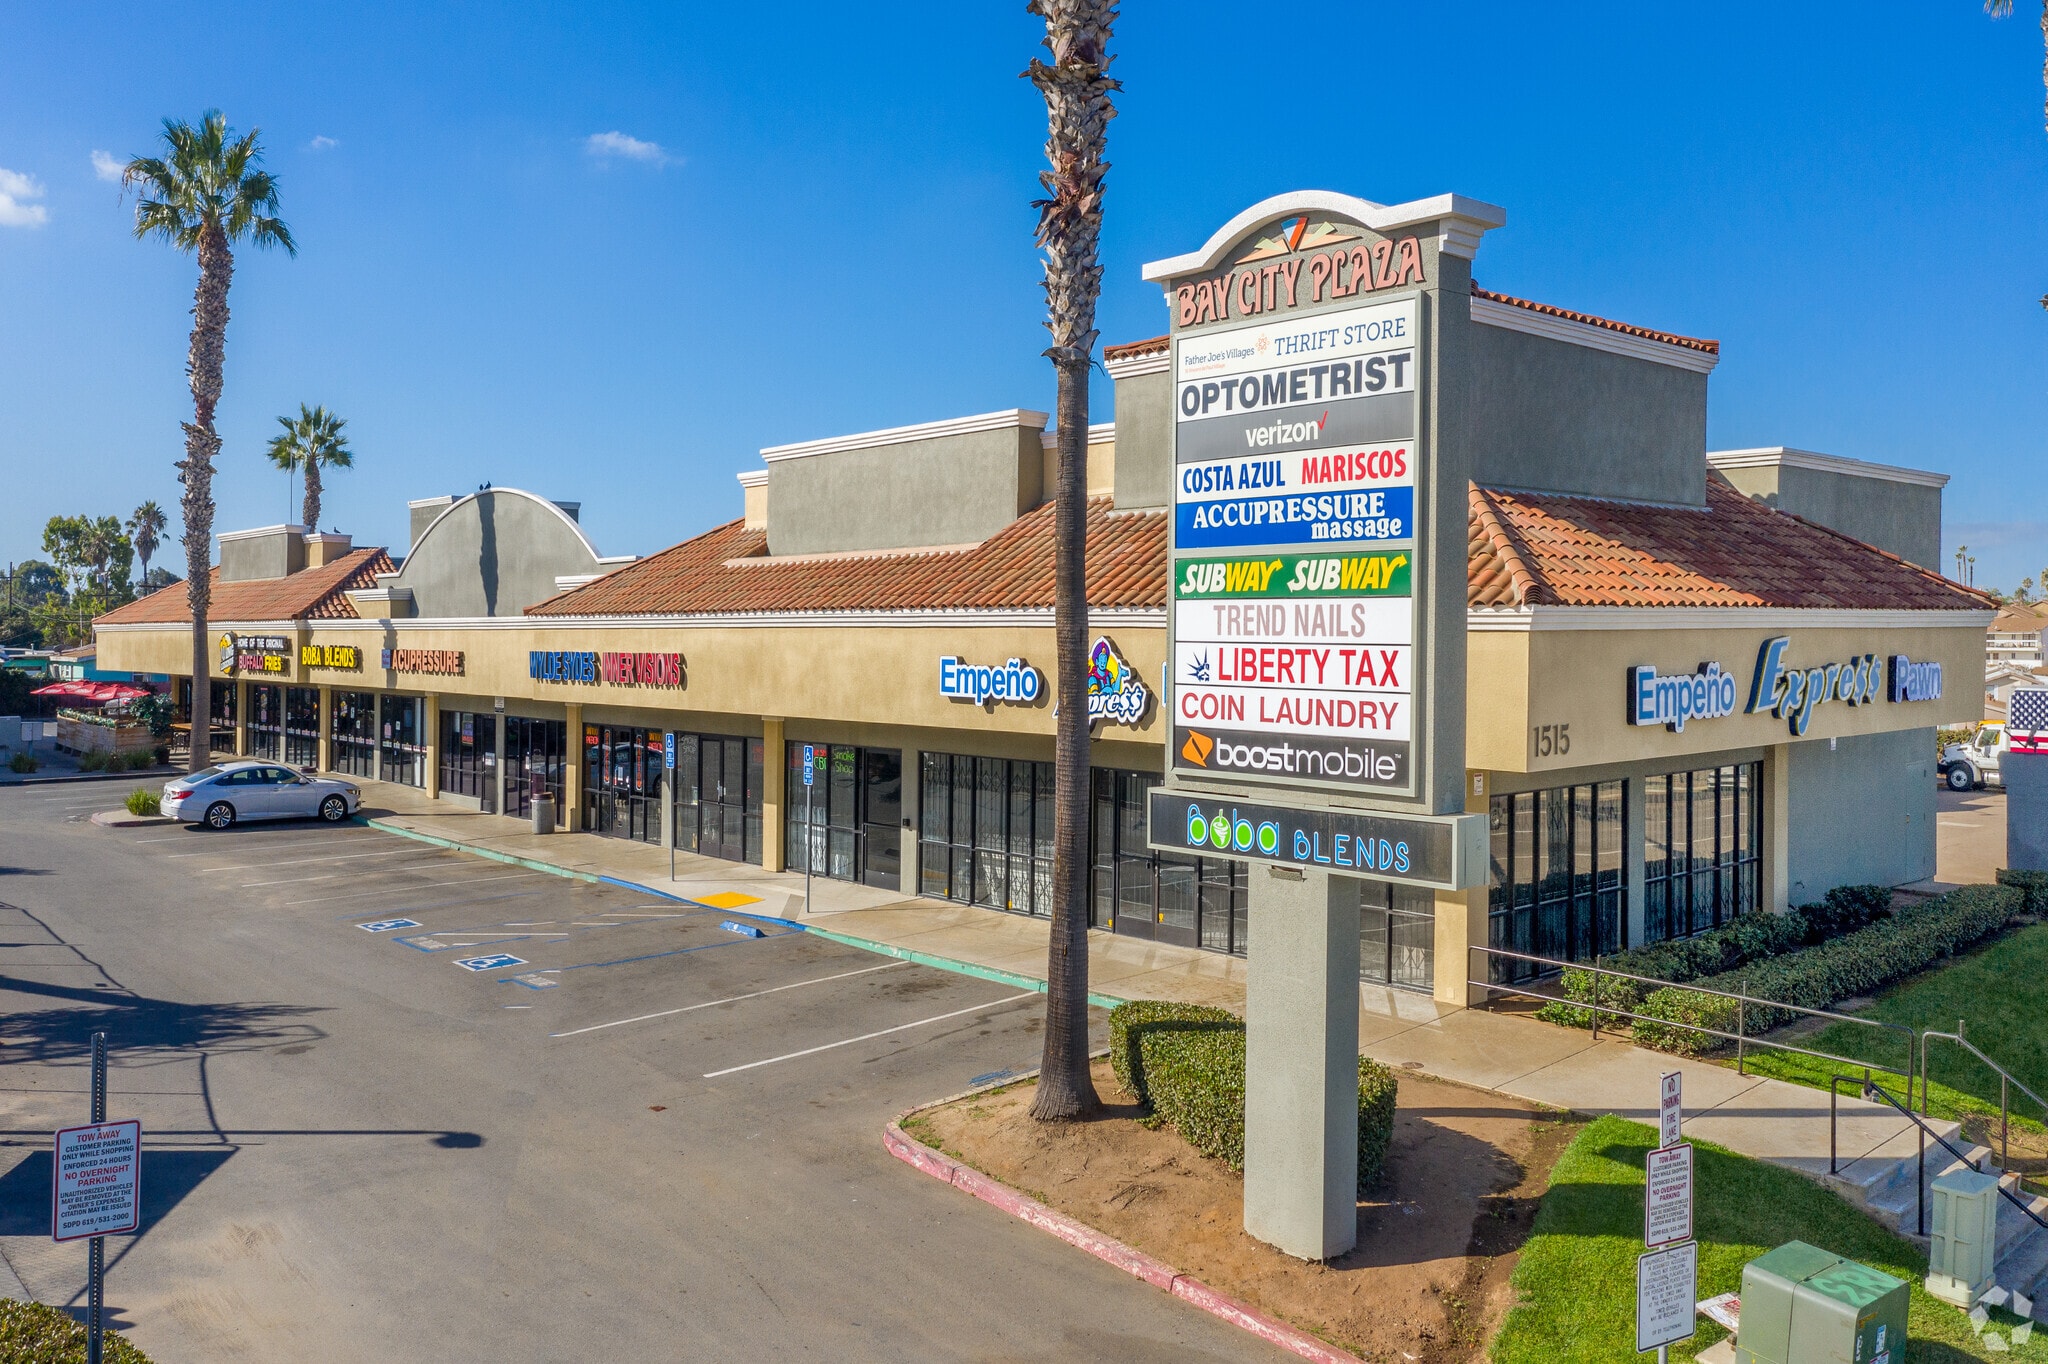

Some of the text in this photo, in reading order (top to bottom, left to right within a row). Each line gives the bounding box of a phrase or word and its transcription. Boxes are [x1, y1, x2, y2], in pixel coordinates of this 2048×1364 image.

[1177, 235, 1425, 327] BAY CITY PLAZA
[1275, 317, 1406, 356] THRIFT STORE
[1185, 347, 1254, 366] Father Joe's Villages
[1181, 353, 1410, 416] OPTOMETRIST
[1246, 419, 1319, 447] verizon
[1183, 449, 1406, 494] COSTA AZUL MARISCOS
[1193, 492, 1386, 528] ACCUPRESSURE
[1312, 518, 1402, 539] massage
[1179, 553, 1407, 595] SUBWAY SUBWAY
[1214, 603, 1366, 638] TREND NAILS
[238, 638, 284, 648] HOME OF THE ORIGINAL
[238, 655, 263, 670] BUFFALO
[264, 655, 282, 671] FRIES
[302, 646, 354, 668] BOBA BLENDS
[392, 649, 460, 672] ACUPRESSURE
[529, 651, 680, 686] WYLDE SYDES INNER VISIONS
[1218, 648, 1399, 687] LIBERTY TAX
[940, 657, 1038, 704] Empeño
[1638, 665, 1735, 729] Empeño
[1896, 656, 1941, 702] Pawn
[1182, 692, 1398, 730] COIN LAUNDRY
[1533, 723, 1570, 758] 1515
[833, 748, 855, 762] Smoke
[834, 761, 854, 776] Shop
[1294, 830, 1410, 872] BLENDS
[1668, 1080, 1675, 1094] NO
[1667, 1112, 1676, 1124] FIRE
[77, 1130, 120, 1143] TOW AWAY
[1666, 1125, 1676, 1139] LANE
[66, 1138, 131, 1152] CUSTOMER PARKING
[80, 1150, 100, 1158] WHILE
[101, 1145, 134, 1155] SHOPPING
[64, 1160, 98, 1170] ENFORCED
[109, 1155, 131, 1163] HOURS
[1669, 1153, 1681, 1162] AWAY
[65, 1164, 130, 1180] NO OVERNIGHT
[78, 1176, 116, 1187] PARKING
[1661, 1182, 1686, 1194] OVERNIGHT
[60, 1182, 133, 1198] UNAUTHORIZED VEHICLES
[84, 1193, 112, 1202] REMOVED
[1660, 1191, 1680, 1201] PARKING
[61, 1209, 87, 1218] CITATION
[111, 1202, 132, 1210] ISSUED
[68, 1197, 125, 1210] OWNER'S EXPENSES
[63, 1220, 80, 1228] SDPD
